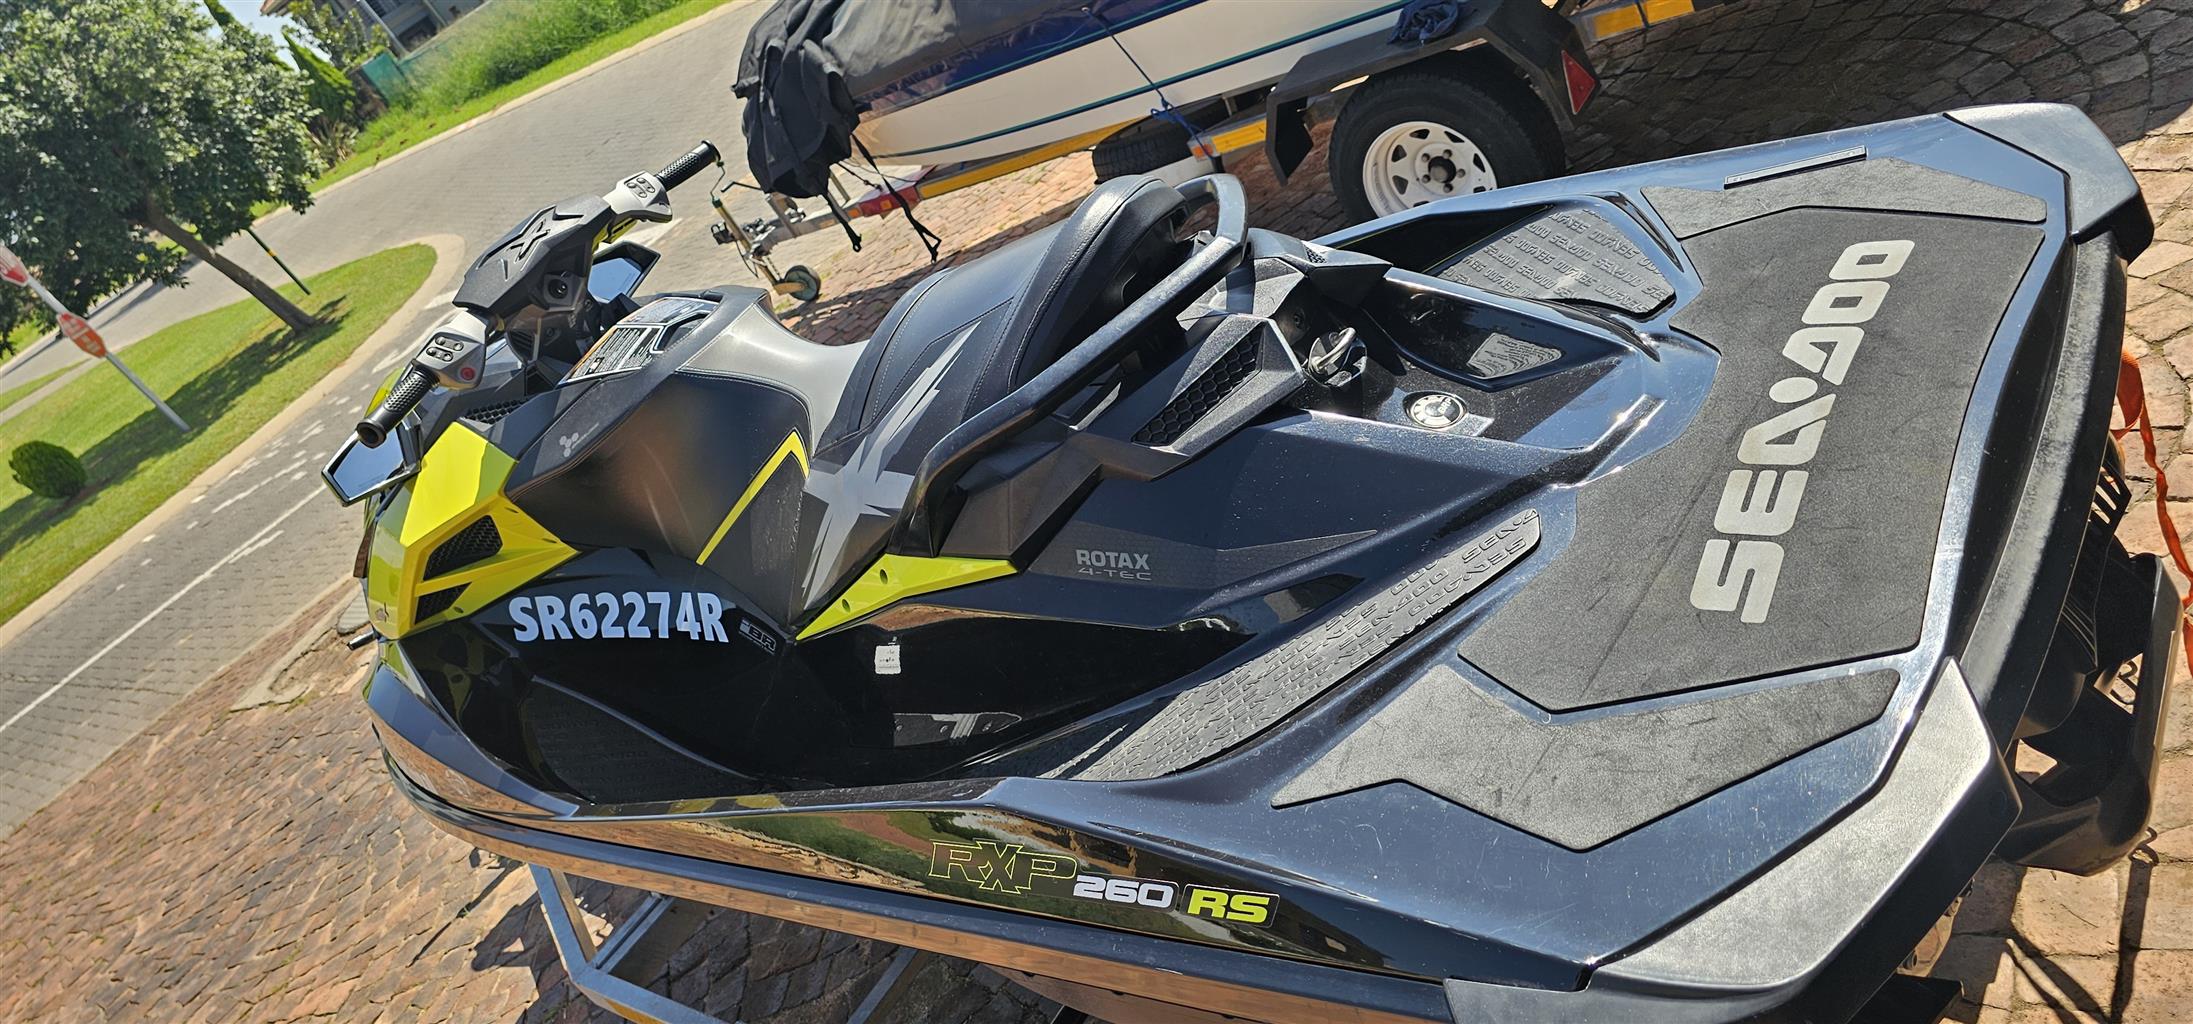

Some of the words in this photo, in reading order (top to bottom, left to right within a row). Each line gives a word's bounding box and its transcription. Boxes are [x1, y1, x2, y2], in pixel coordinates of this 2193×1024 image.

[1076, 549, 1150, 570] ROTAX
[1078, 567, 1152, 581] 4-TEC
[508, 591, 729, 644] SR62274R
[928, 838, 1078, 895] RXP
[1072, 874, 1175, 908] 260
[1187, 888, 1270, 924] RS
